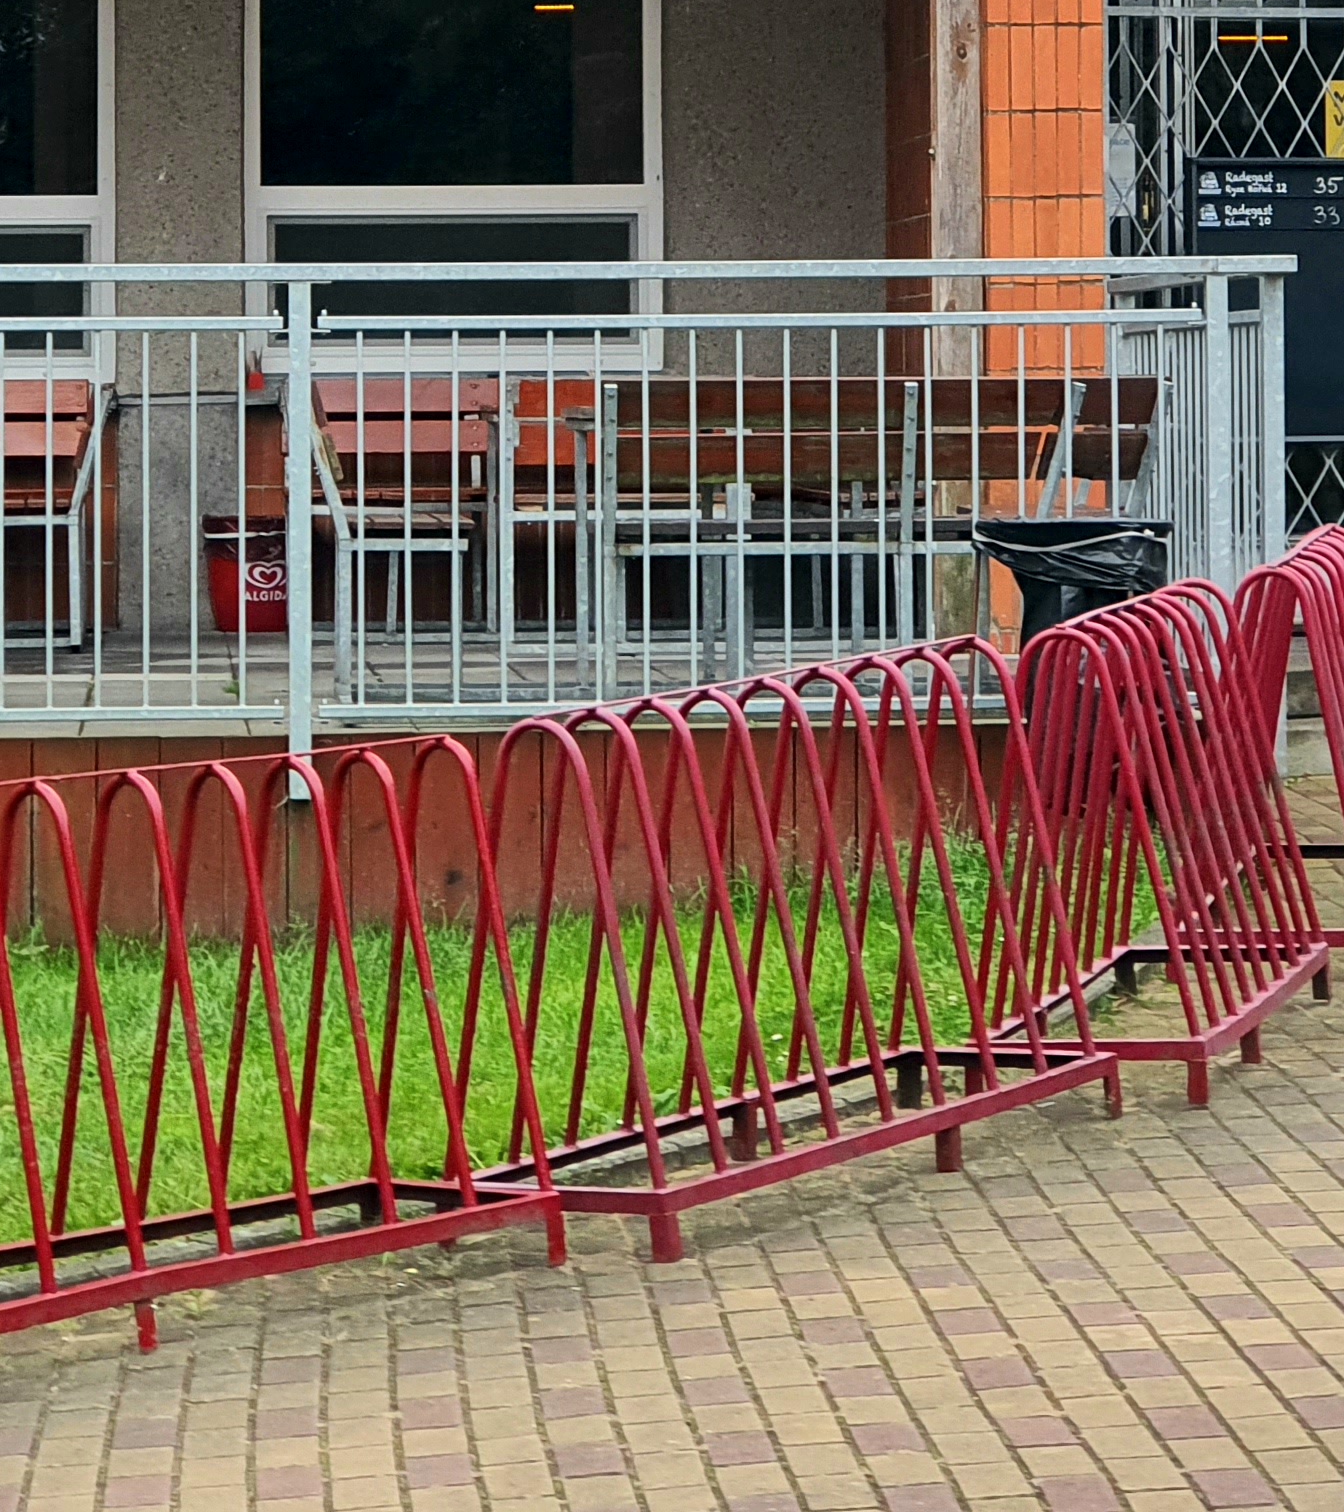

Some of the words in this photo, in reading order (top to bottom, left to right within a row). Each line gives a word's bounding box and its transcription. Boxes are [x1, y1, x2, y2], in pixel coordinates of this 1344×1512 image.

[1225, 170, 1274, 185] Radegast
[1313, 176, 1344, 194] 35
[1275, 182, 1288, 194] 12
[1224, 203, 1273, 219] Radegast
[1313, 205, 1341, 225] 33
[1258, 216, 1272, 227] 10
